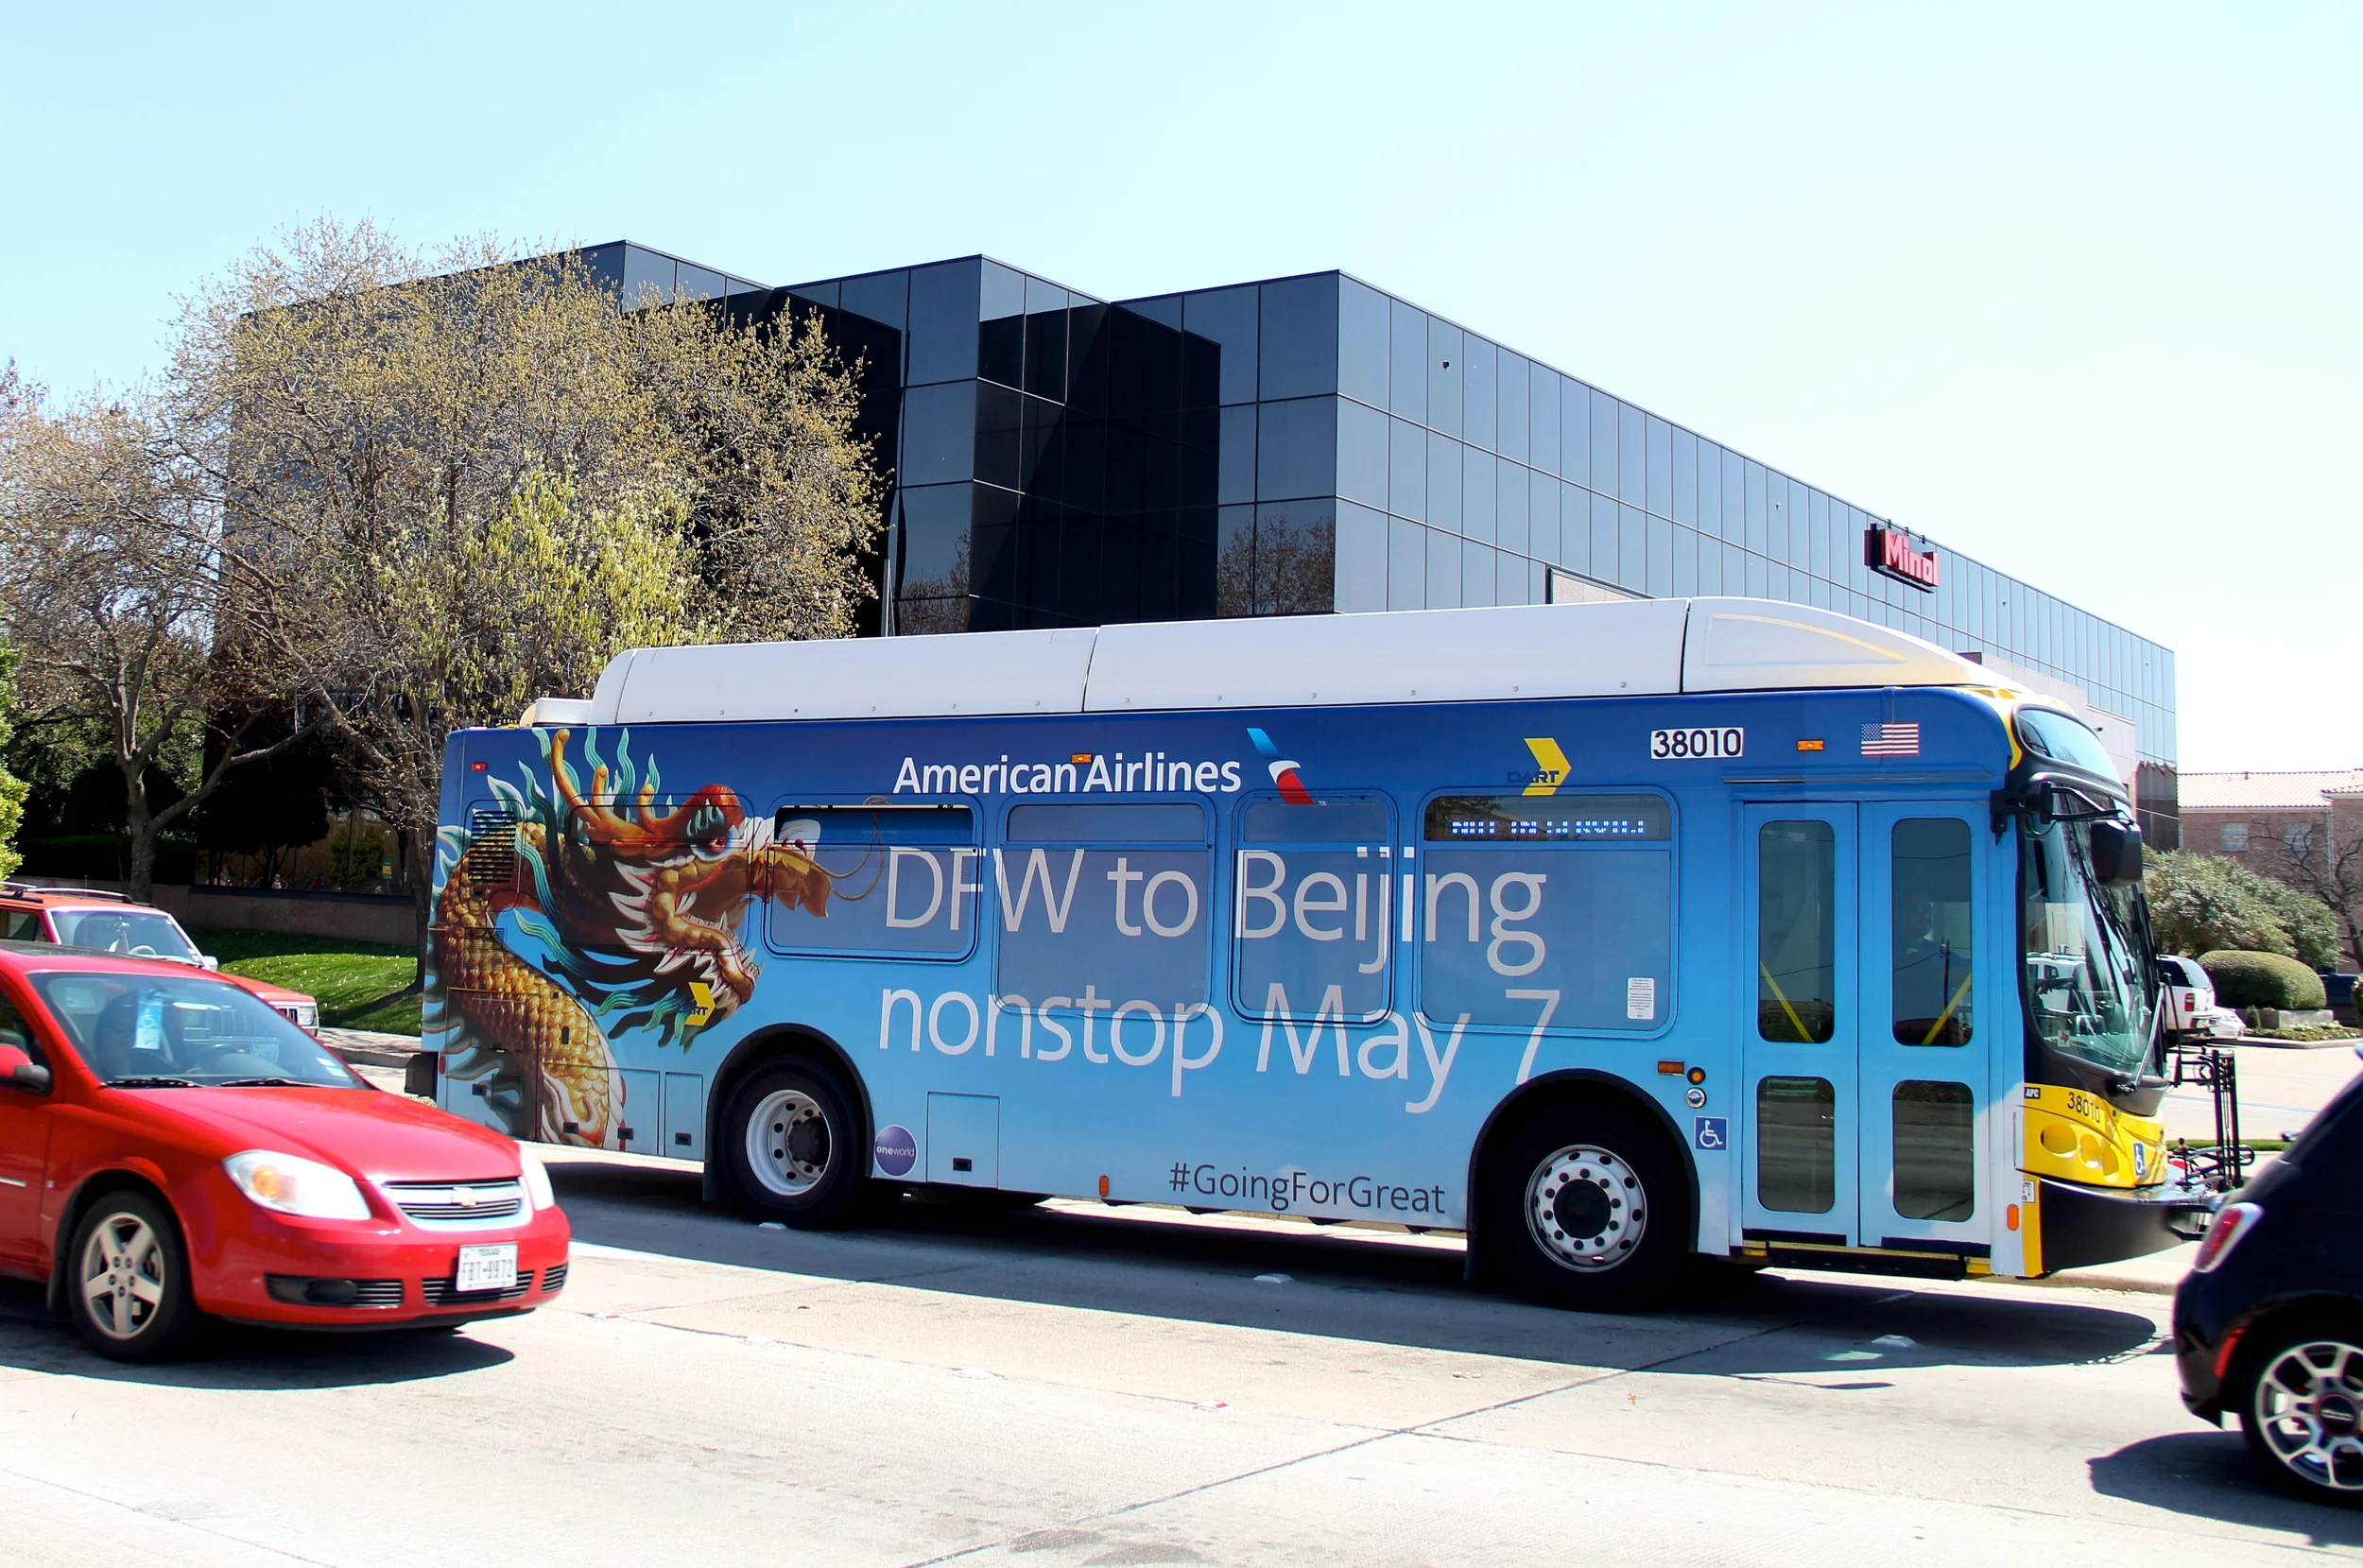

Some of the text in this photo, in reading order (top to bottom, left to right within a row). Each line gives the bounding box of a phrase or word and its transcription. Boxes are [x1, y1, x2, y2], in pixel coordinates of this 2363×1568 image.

[1653, 729, 1741, 757] 38010
[893, 752, 1241, 794] American Airlines
[1507, 770, 1560, 784] DART
[885, 846, 1547, 976] DFW to Beijing
[880, 983, 1560, 1113] nonstop May 7
[2026, 1088, 2039, 1097] APC
[2067, 1092, 2100, 1123] 38010
[876, 1146, 915, 1157] oneworld
[1169, 1162, 1445, 1215] #GoingForGreat
